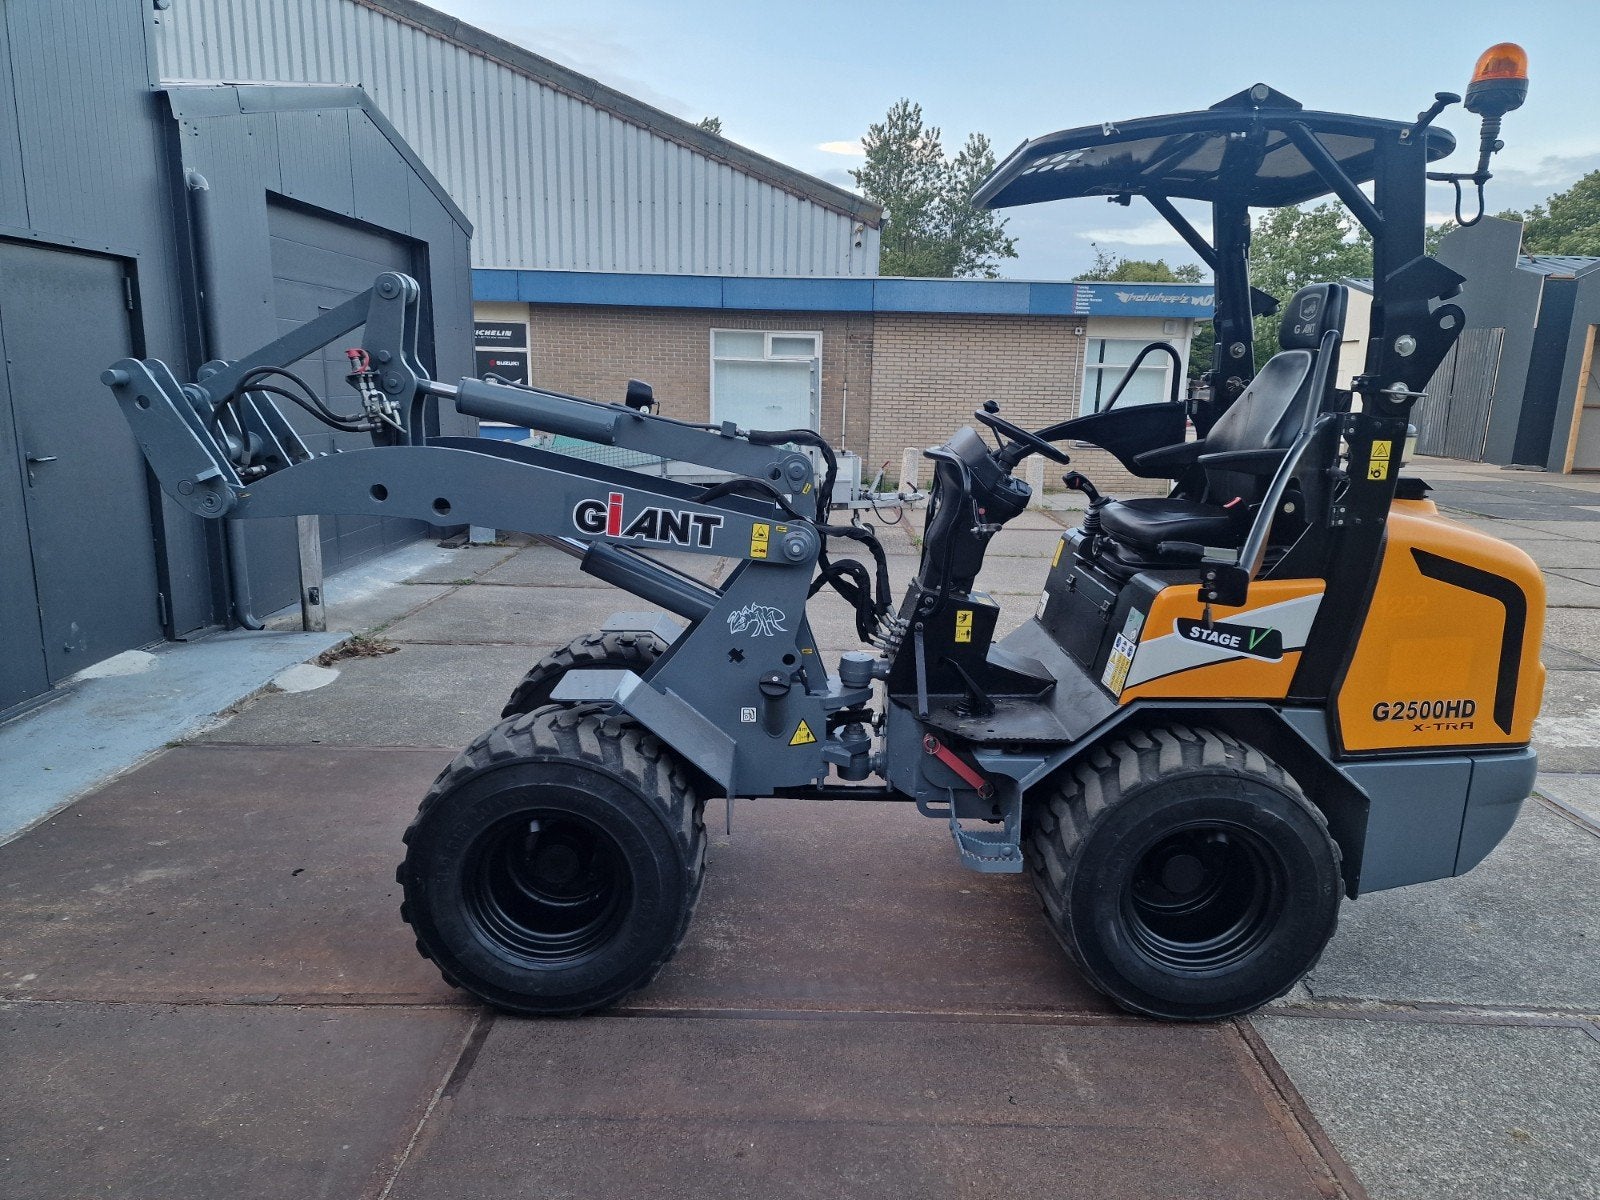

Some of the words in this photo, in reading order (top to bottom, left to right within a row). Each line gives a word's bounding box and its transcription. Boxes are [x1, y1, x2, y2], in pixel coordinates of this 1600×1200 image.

[1189, 626, 1242, 648] STAGE
[1248, 626, 1273, 651] V
[1372, 699, 1476, 722] G2500HD
[1413, 721, 1474, 732] X-TRA
